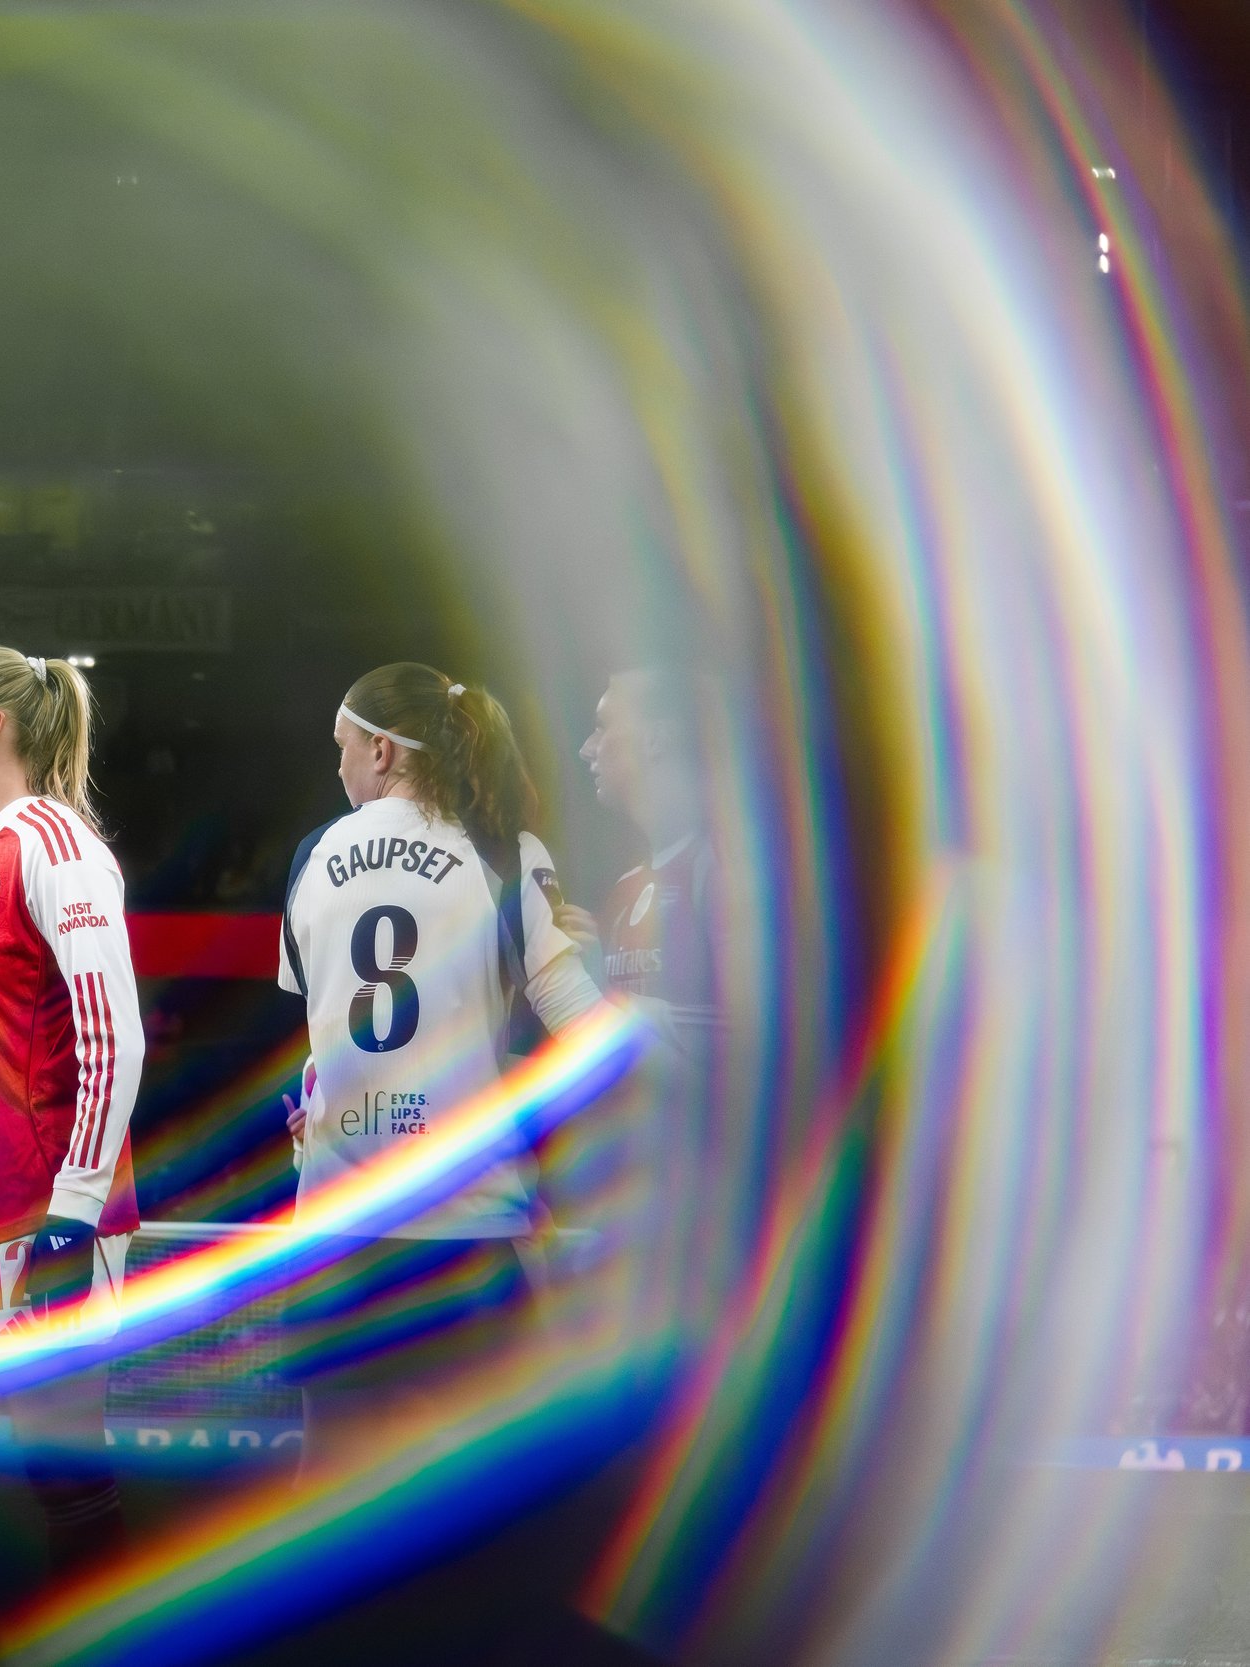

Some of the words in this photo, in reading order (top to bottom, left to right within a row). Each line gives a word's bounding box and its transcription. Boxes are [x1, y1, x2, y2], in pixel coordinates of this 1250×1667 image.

[327, 838, 463, 887] GAUPSET
[62, 902, 93, 917] VISIT
[58, 915, 109, 936] RWANDA
[605, 946, 662, 976] mirates
[349, 905, 419, 1052] 8
[391, 1093, 430, 1106] EYES.
[391, 1108, 425, 1120] LIPS.
[391, 1122, 430, 1135] FACE.
